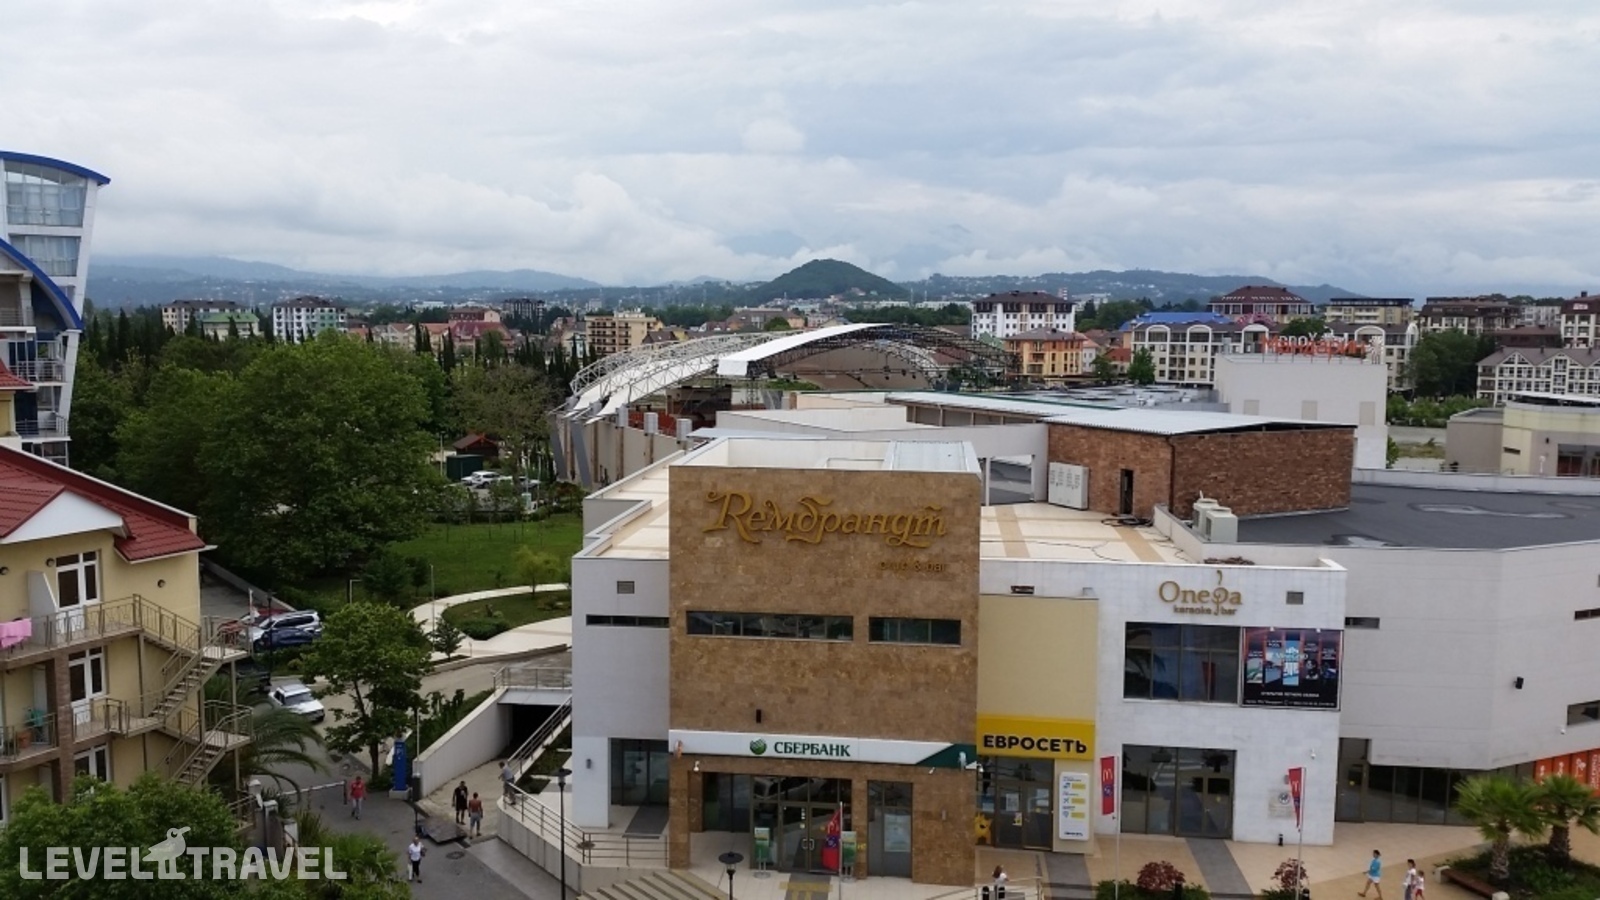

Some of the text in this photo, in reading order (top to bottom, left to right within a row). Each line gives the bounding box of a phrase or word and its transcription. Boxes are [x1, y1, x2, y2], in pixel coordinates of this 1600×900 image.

[1173, 604, 1237, 616] karaoke bar
[774, 741, 851, 757] СБЕРБАНК
[983, 734, 1087, 754] ЕВРОСЕТЬ
